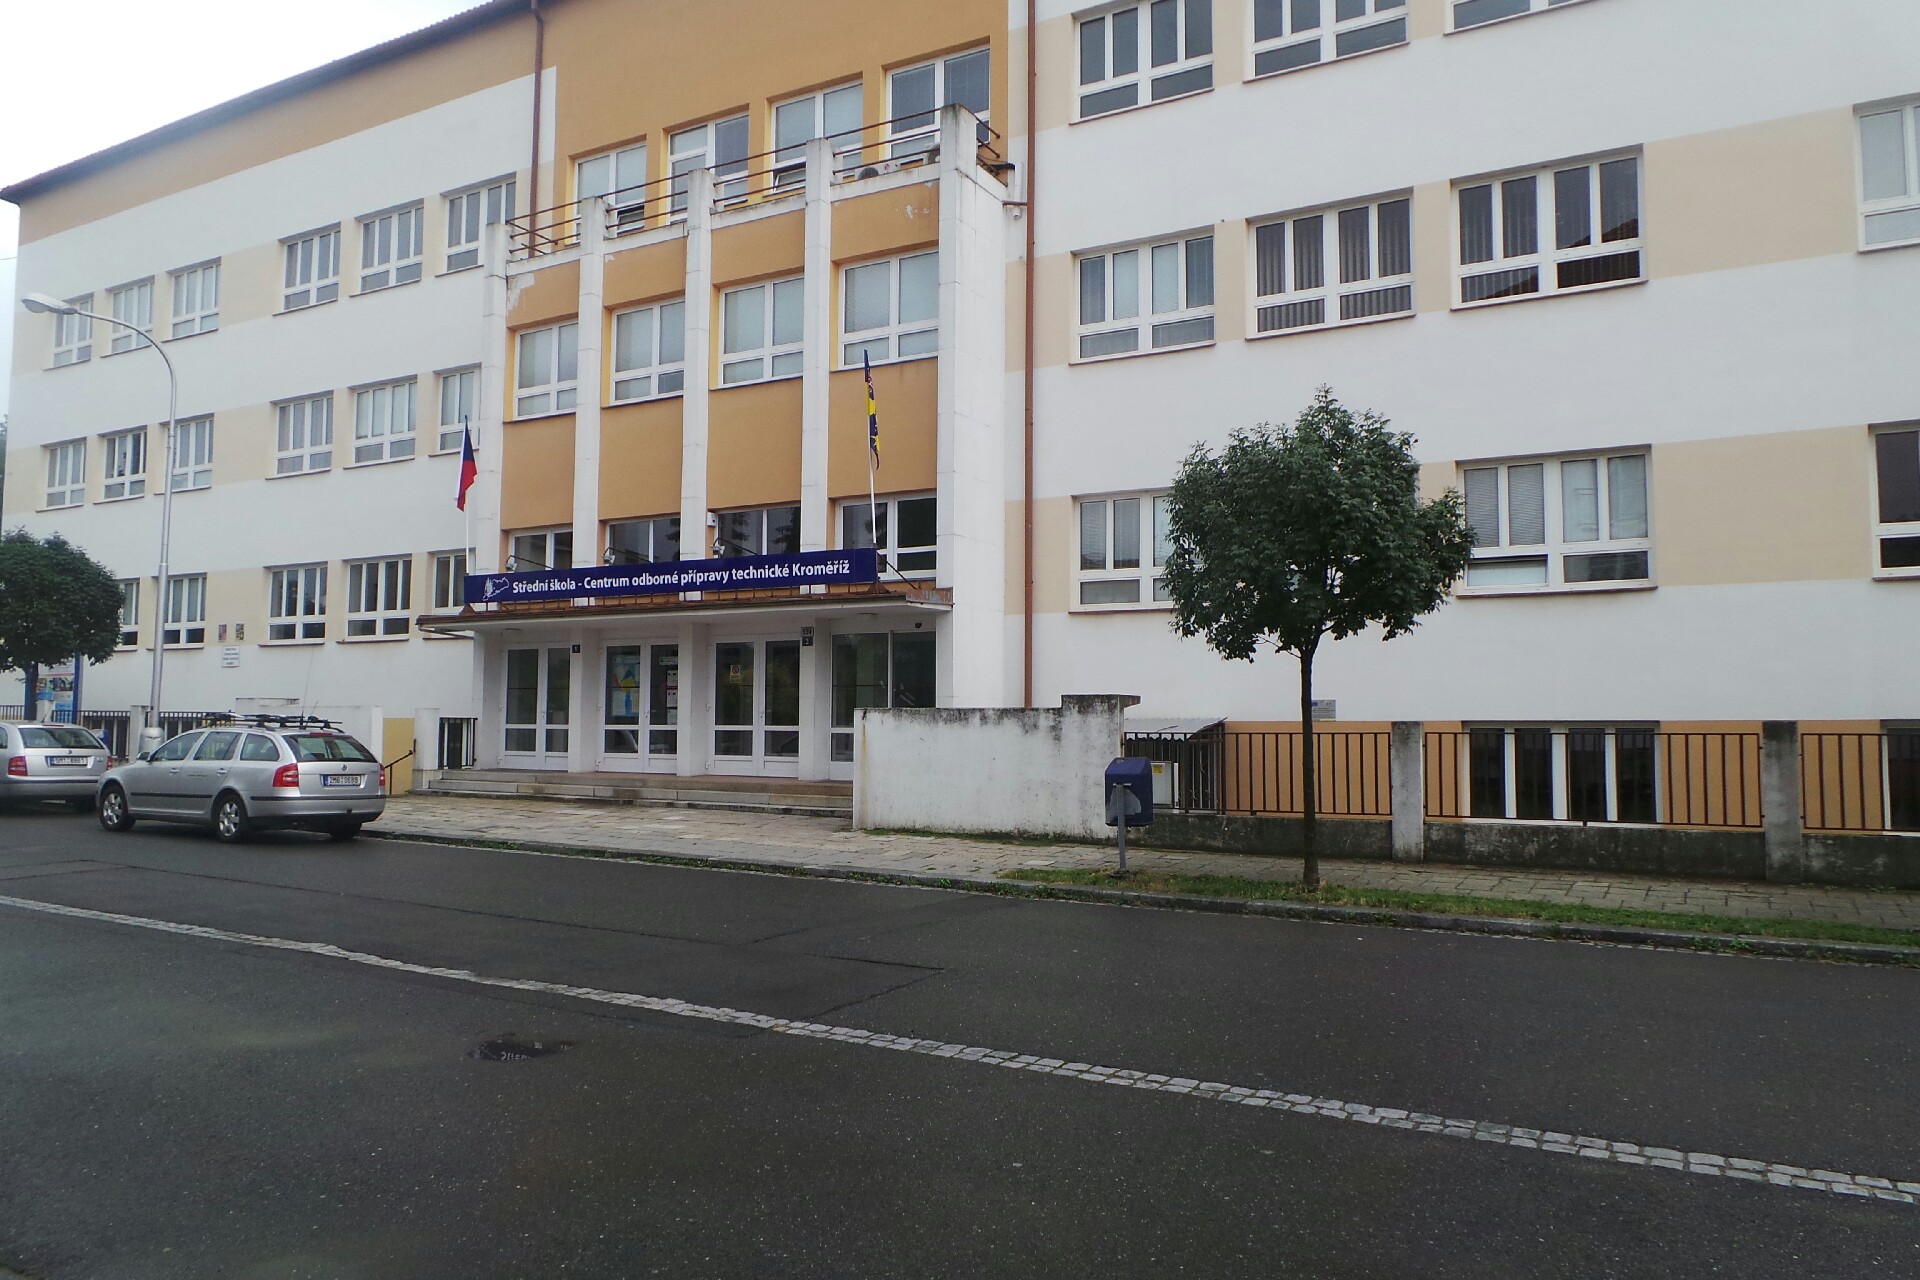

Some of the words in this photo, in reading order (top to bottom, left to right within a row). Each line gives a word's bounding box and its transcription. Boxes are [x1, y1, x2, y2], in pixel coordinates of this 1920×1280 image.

[513, 579, 549, 594] Střední
[550, 578, 576, 591] škola
[584, 576, 629, 589] Centrum
[632, 570, 679, 586] odborné
[680, 569, 730, 587] přípravy
[732, 563, 790, 581] technické
[792, 559, 850, 577] Kroměříž
